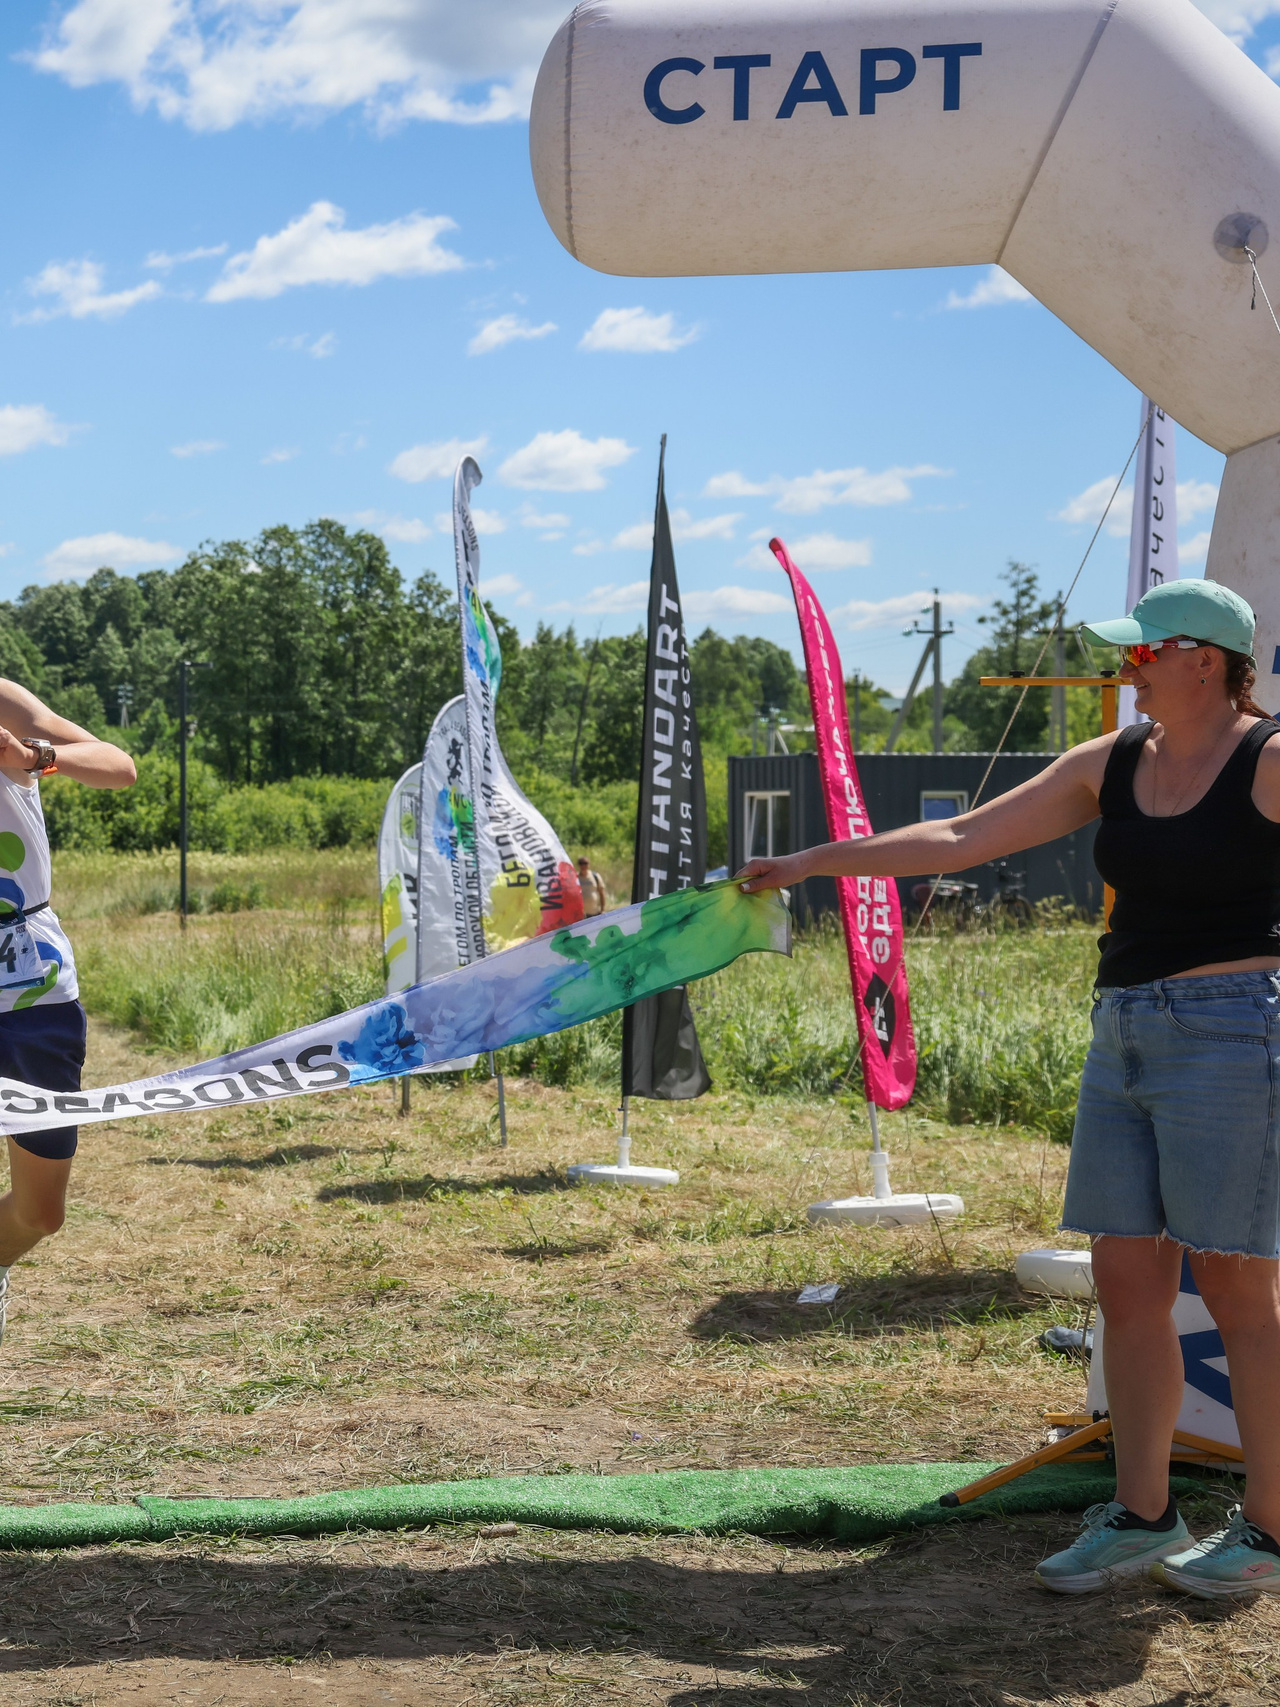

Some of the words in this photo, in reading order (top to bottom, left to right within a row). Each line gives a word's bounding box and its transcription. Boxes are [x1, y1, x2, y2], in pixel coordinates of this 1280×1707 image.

[643, 42, 983, 126] СТАРТ
[455, 926, 471, 967] ЕГОМ
[872, 878, 893, 964] ЗДЕ
